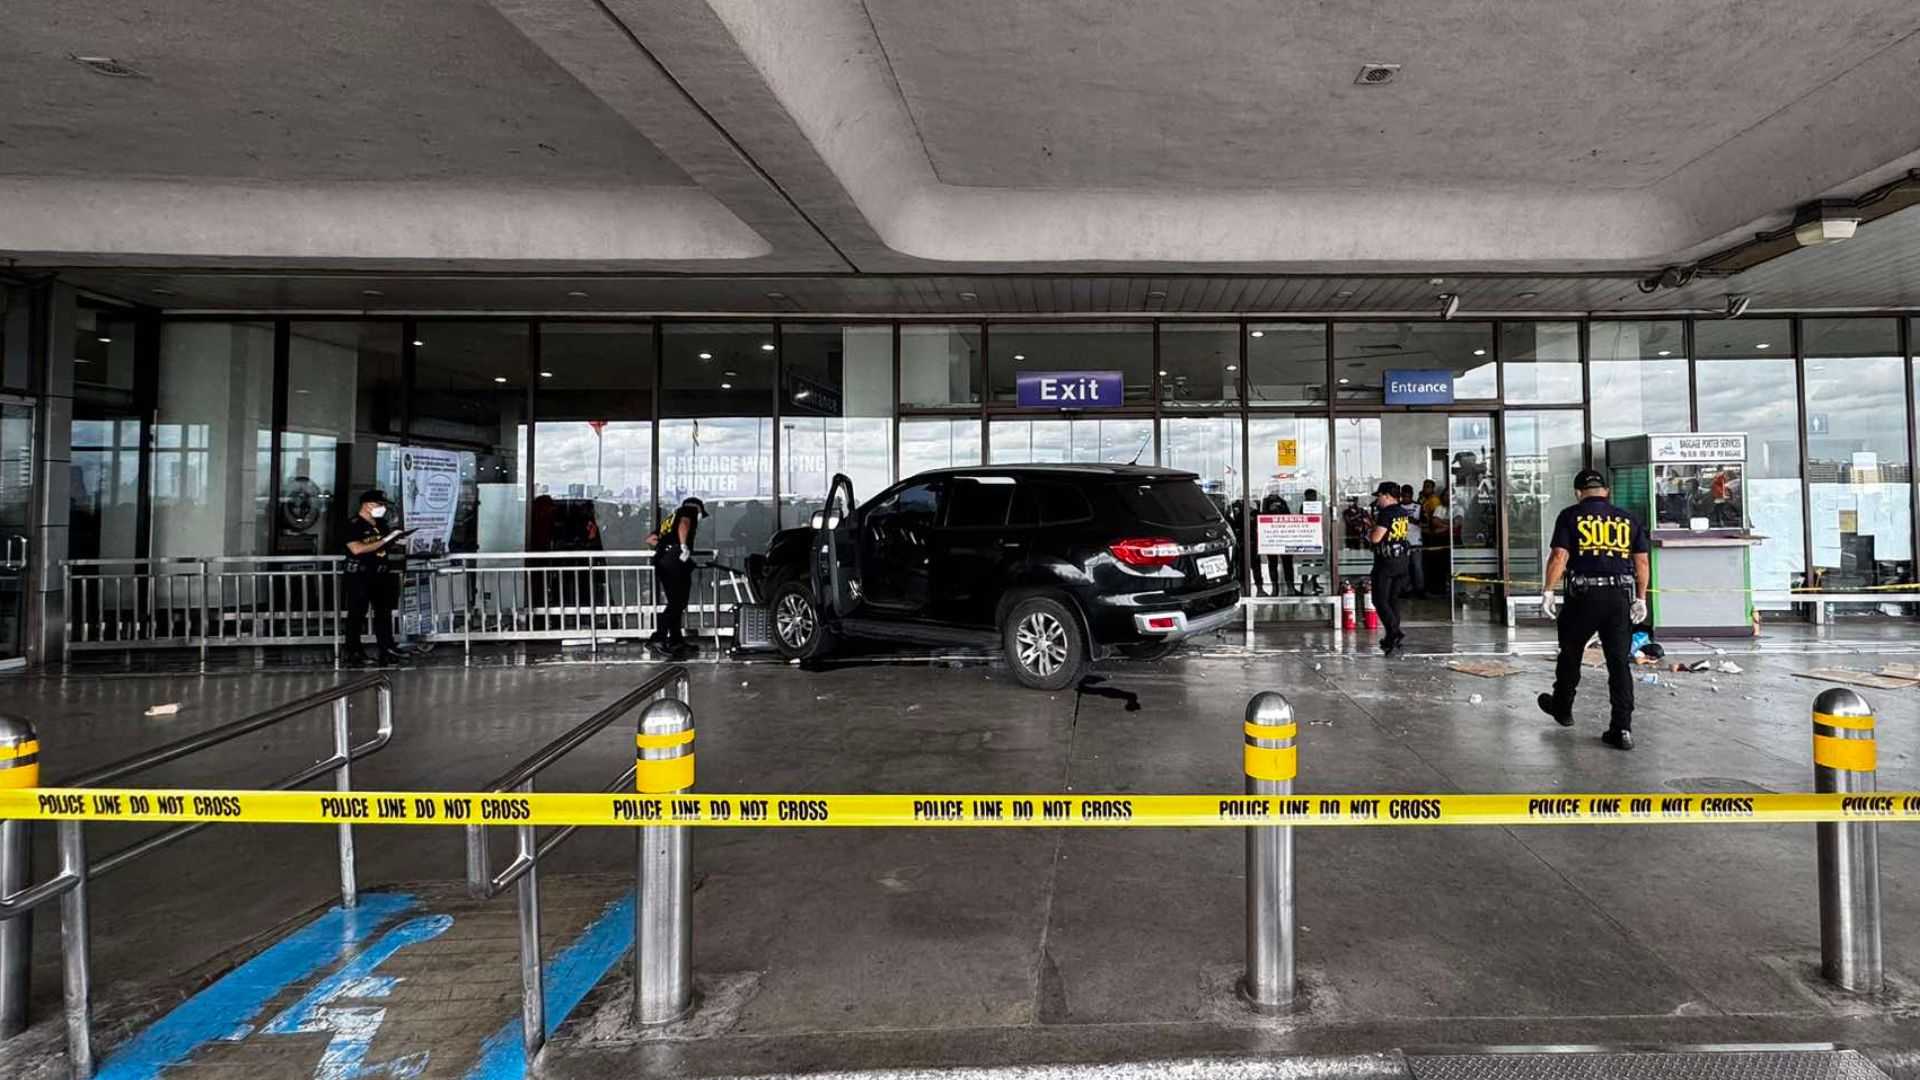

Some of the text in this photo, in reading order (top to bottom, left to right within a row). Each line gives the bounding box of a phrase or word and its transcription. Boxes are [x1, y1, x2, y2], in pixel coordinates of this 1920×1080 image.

[1040, 378, 1099, 401] Exit
[1391, 381, 1448, 393] Entrance
[1680, 439, 1742, 449] BAGGAGE PORTER SERVICES
[666, 455, 825, 473] BAGGAGE WRPPING
[666, 474, 737, 491] COUNTER
[1577, 519, 1630, 548] SOCO
[38, 794, 241, 817] POLICE LINE DO NOT CROSS
[320, 797, 530, 820] POLICE LINE DO NOT CROSS
[612, 799, 829, 821] POLICE LINE DO NOT CROSS
[913, 800, 1133, 820] POLICE LINE DO NOT CROSS
[1219, 799, 1441, 820] POLICE LINE DO NOT CROSS
[1528, 798, 1754, 817] POLICE LINE DO NOT CROSS
[1841, 796, 1920, 816] POLICE LI
